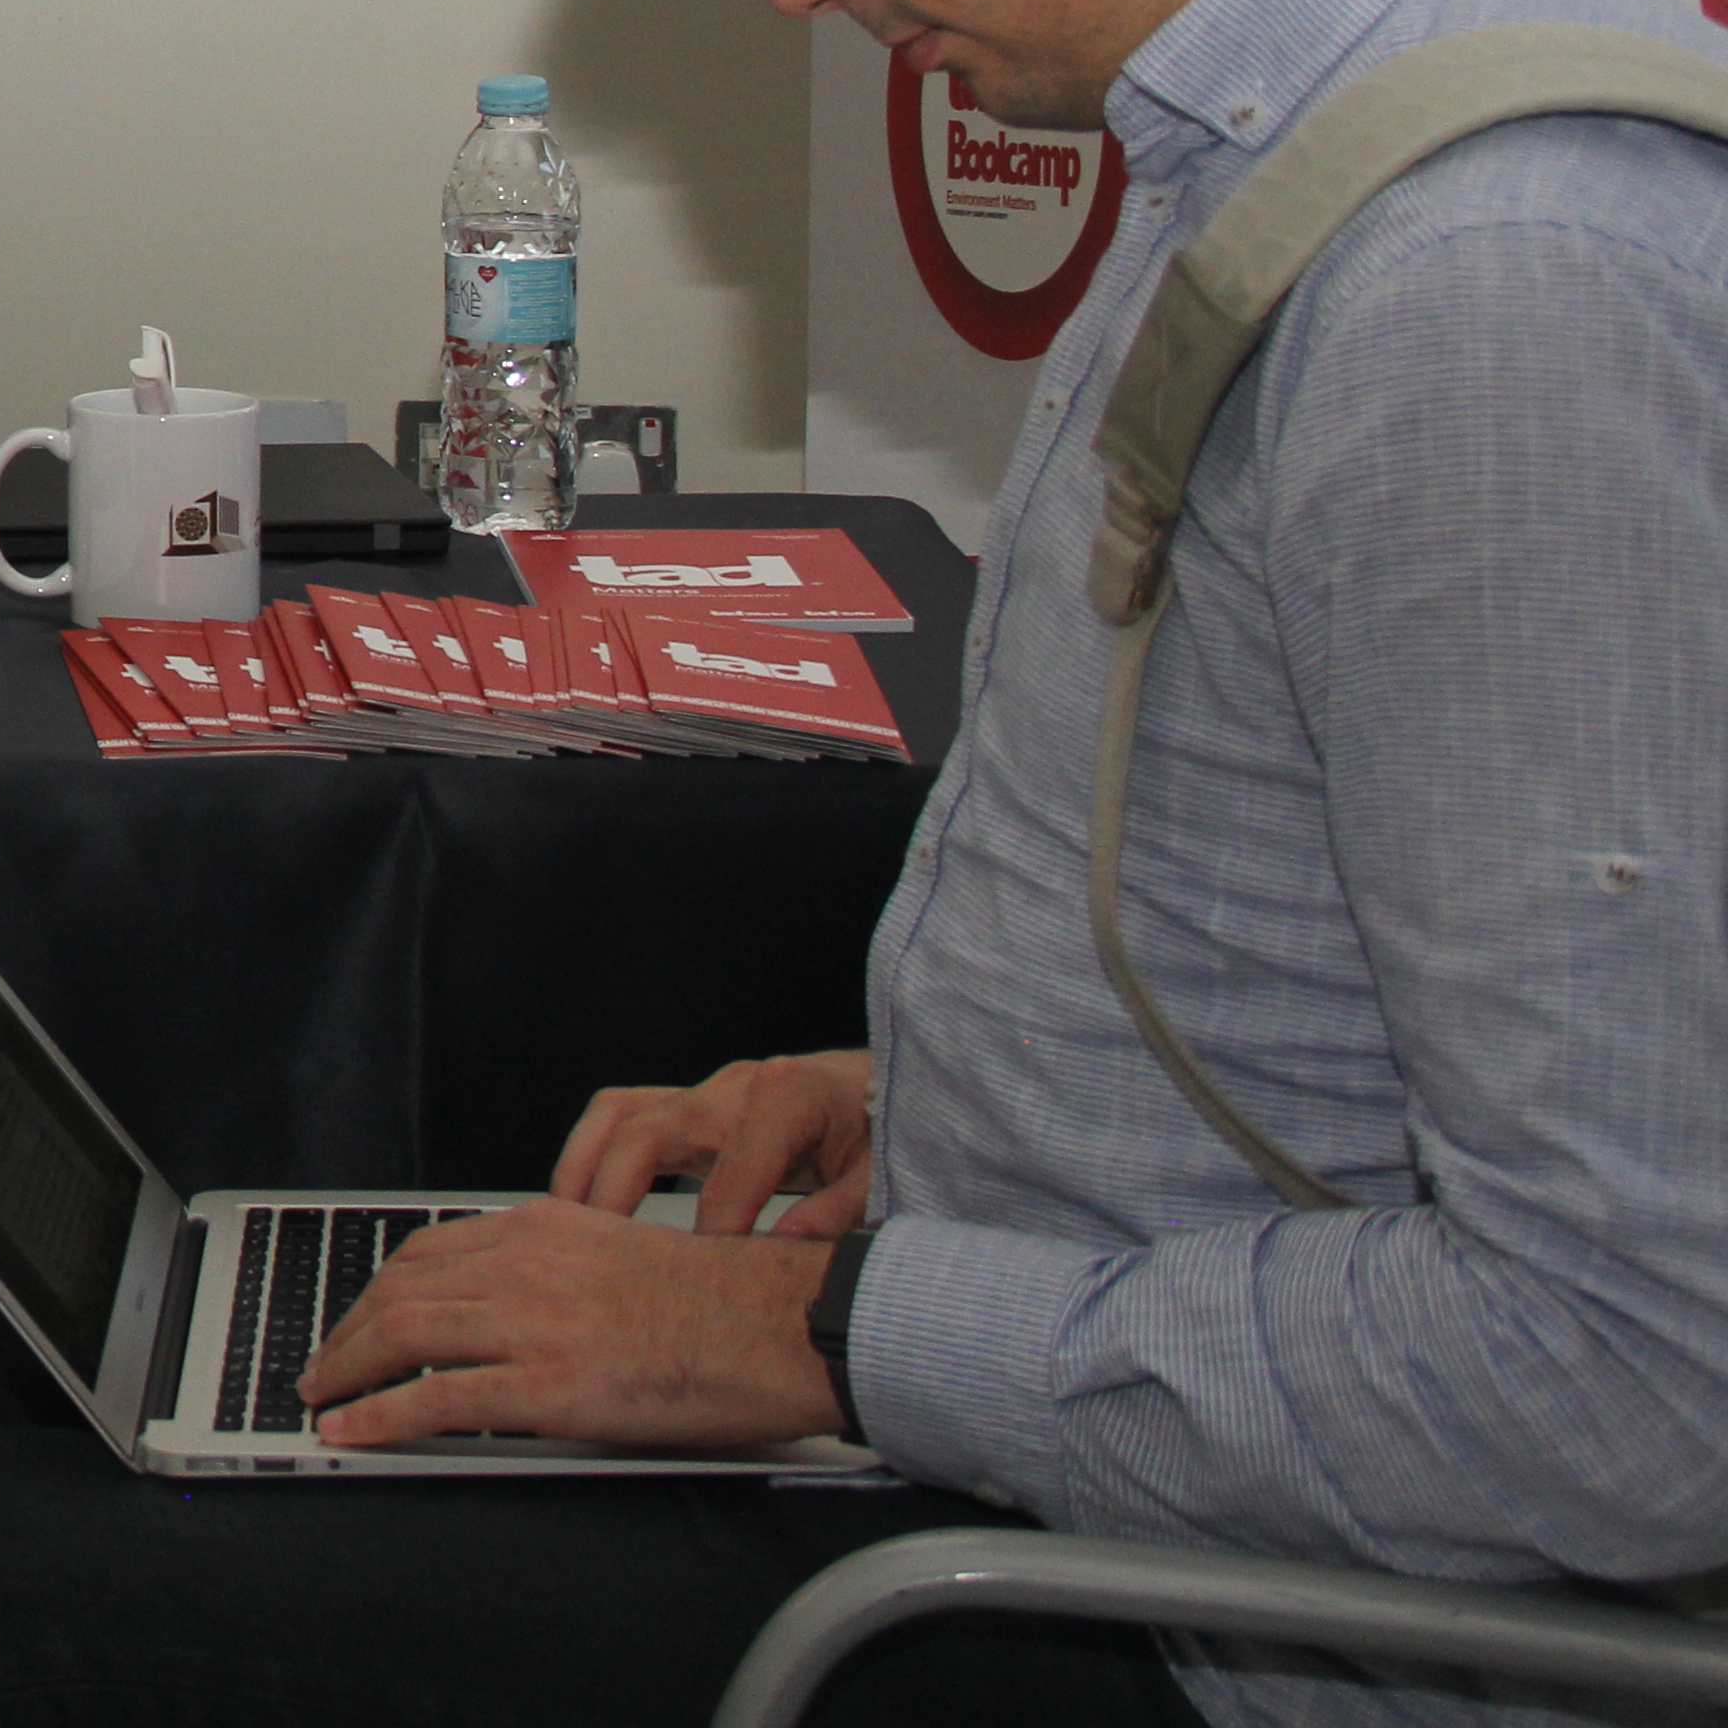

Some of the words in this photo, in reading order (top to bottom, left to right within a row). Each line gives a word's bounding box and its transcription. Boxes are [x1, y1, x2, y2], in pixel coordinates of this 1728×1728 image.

[947, 120, 1081, 207] Bootcamp
[570, 555, 803, 587] tad
[661, 641, 837, 687] tad
